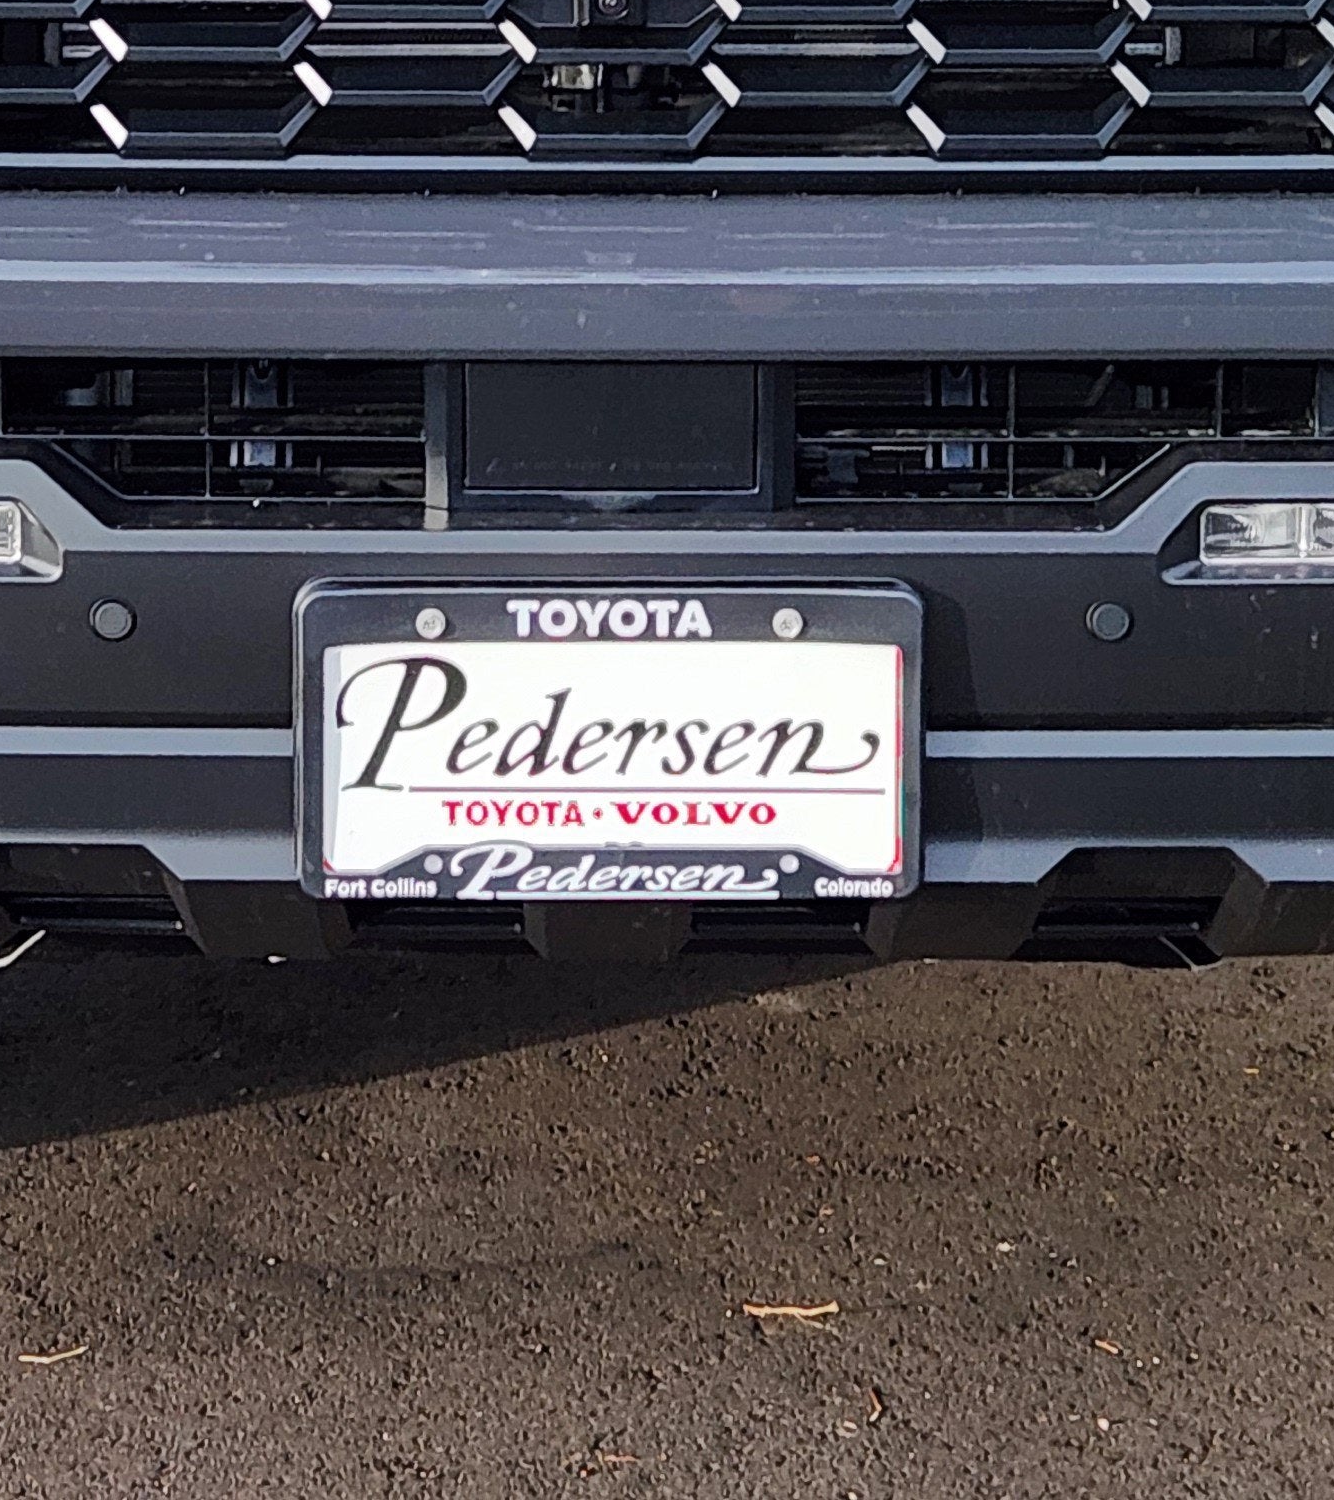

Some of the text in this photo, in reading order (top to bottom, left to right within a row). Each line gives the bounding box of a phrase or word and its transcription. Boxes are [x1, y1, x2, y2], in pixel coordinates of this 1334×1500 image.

[506, 599, 712, 638] TOYOTA
[335, 656, 881, 792] Pedersen
[442, 800, 777, 827] TOYOTA VOLVO
[324, 877, 438, 899] Fort Collins
[449, 843, 779, 900] Pedersen
[814, 876, 894, 899] Colorado
